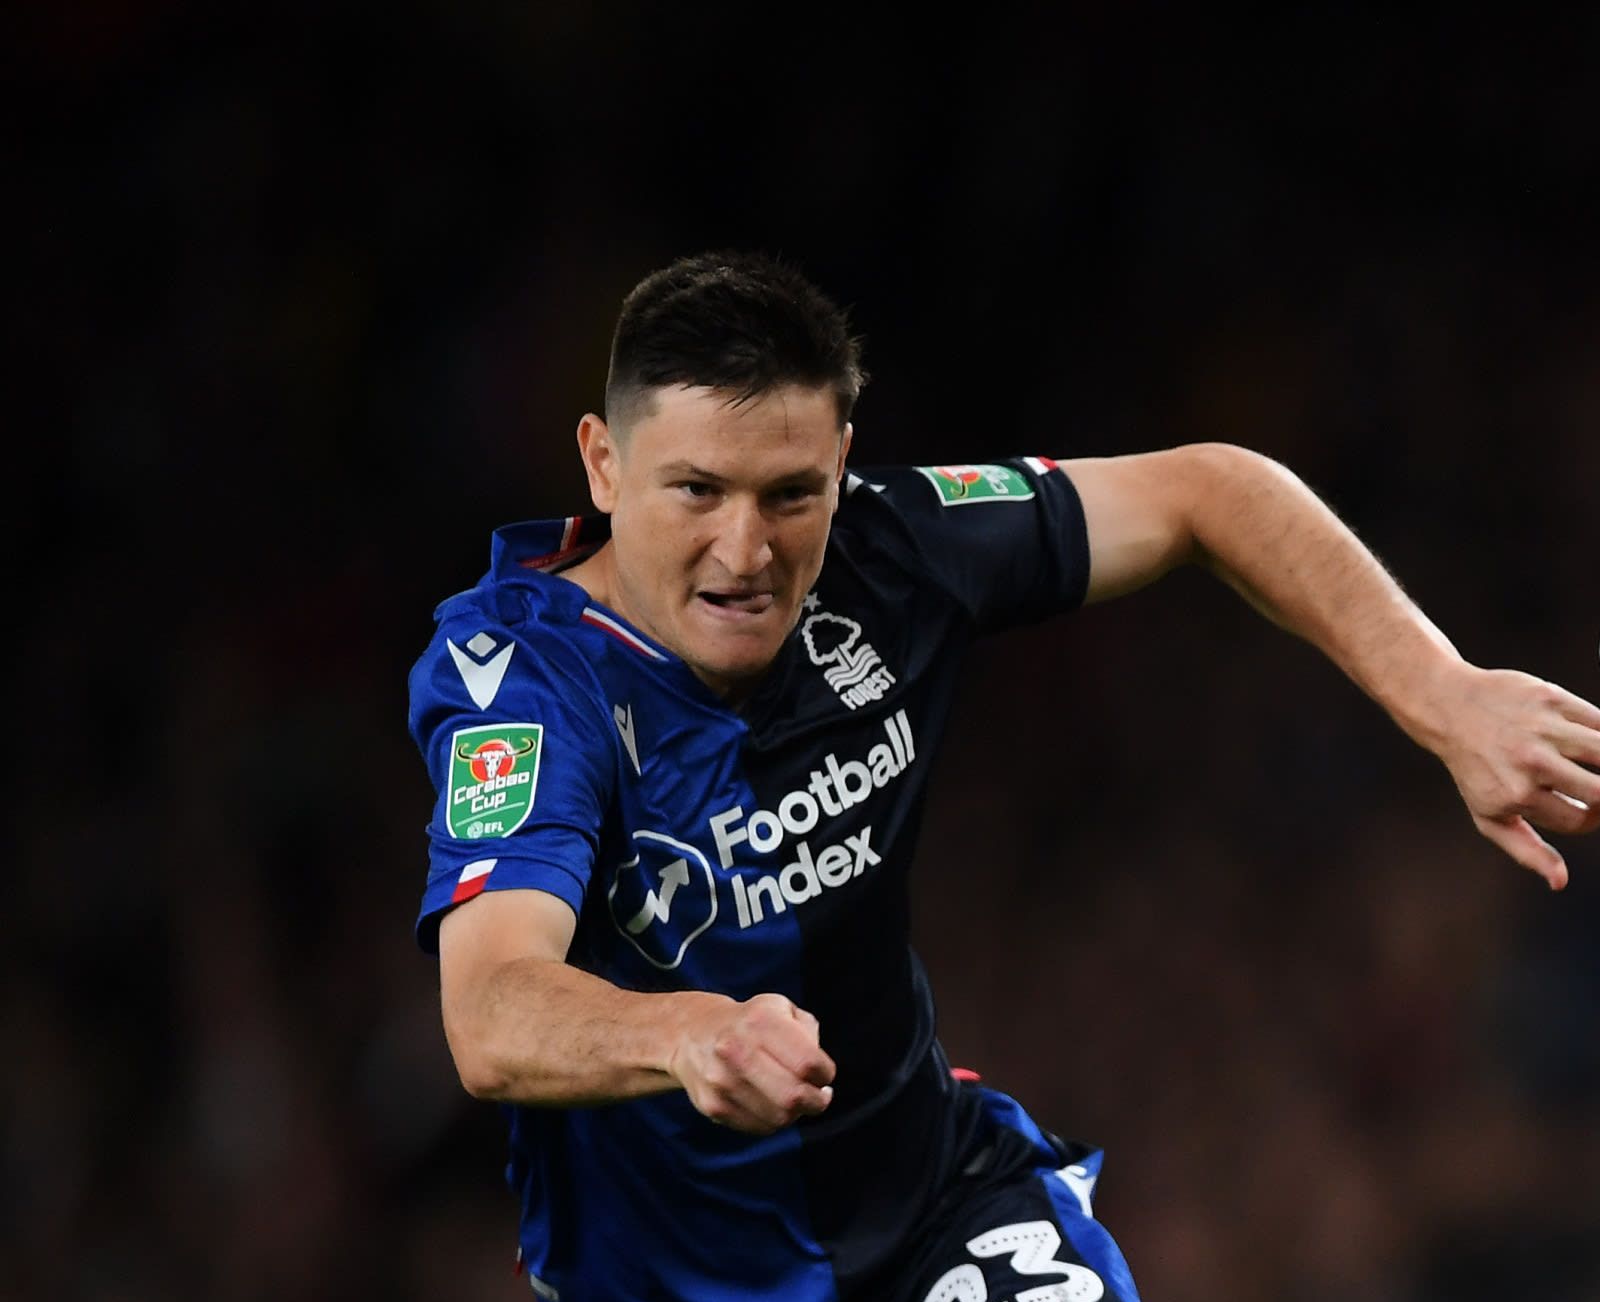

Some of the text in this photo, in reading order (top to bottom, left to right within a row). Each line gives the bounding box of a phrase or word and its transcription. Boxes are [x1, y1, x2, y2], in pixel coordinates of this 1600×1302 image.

[840, 665, 897, 711] FOREST
[454, 771, 530, 805] Carabao
[471, 791, 507, 814] Cup
[709, 708, 915, 871] Football
[484, 821, 504, 834] EFL
[731, 825, 882, 929] Index
